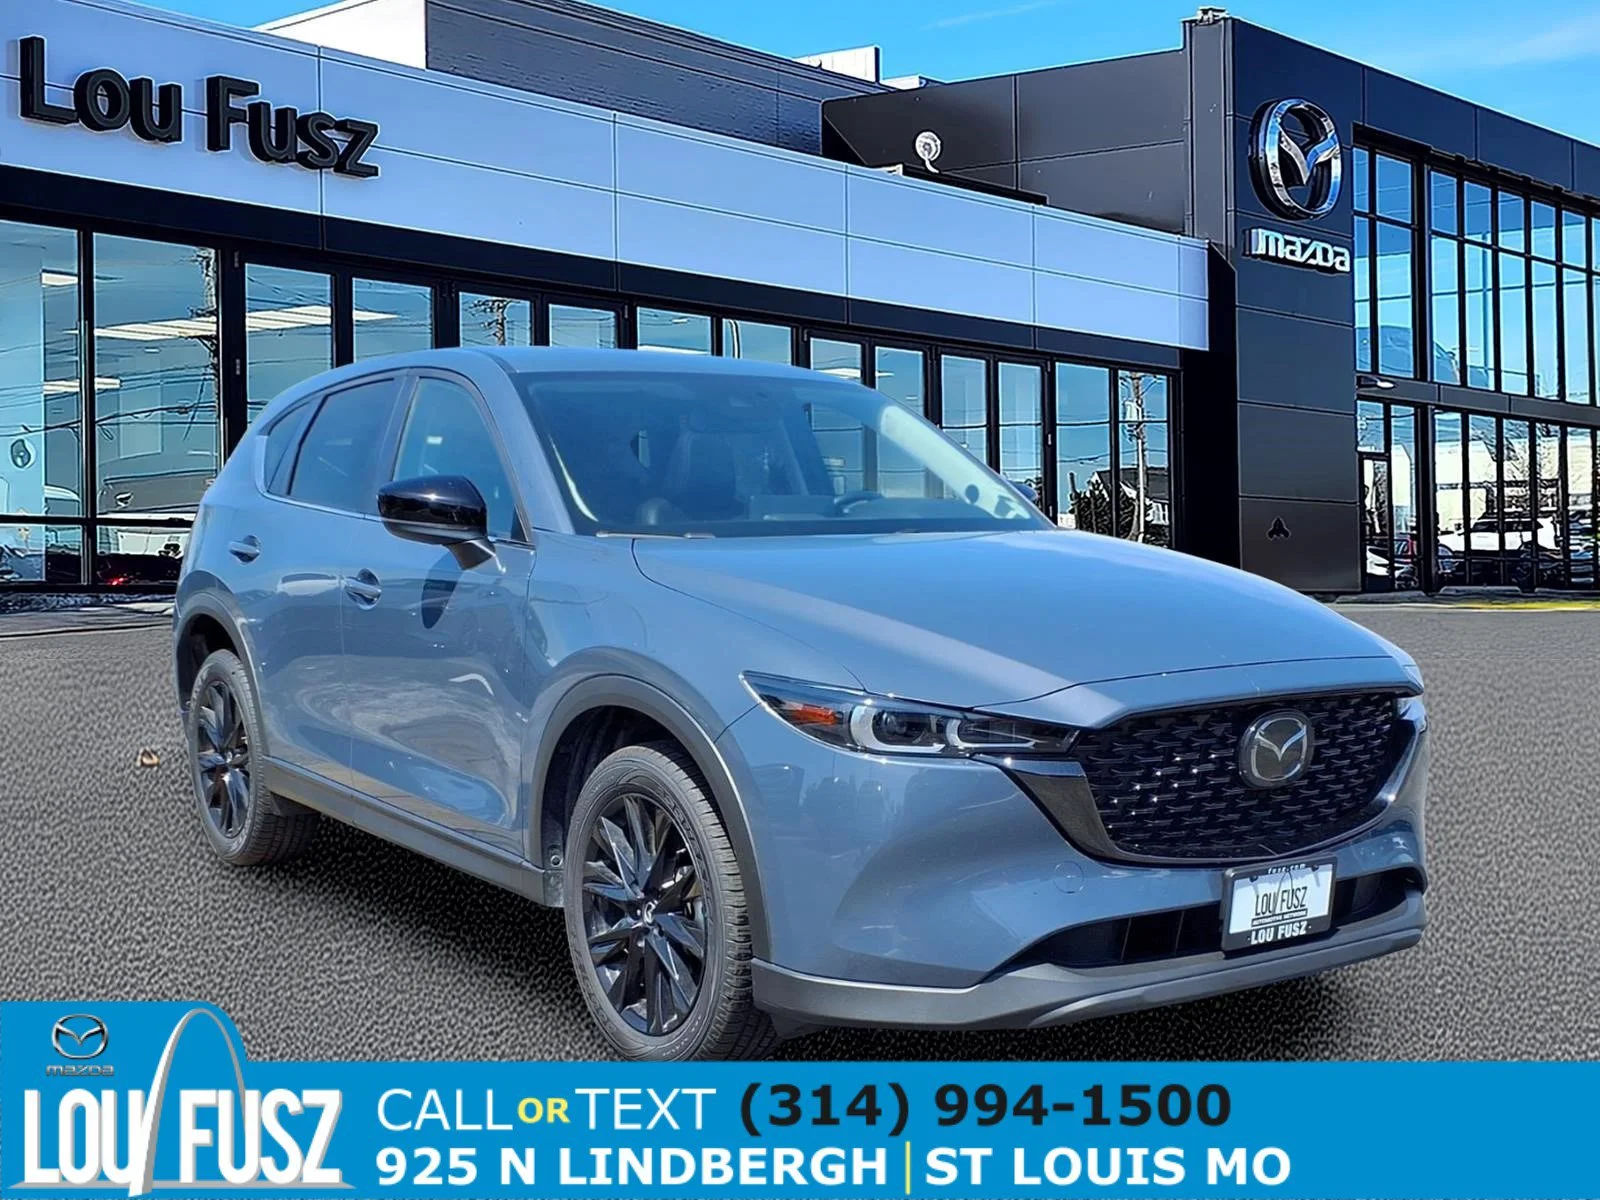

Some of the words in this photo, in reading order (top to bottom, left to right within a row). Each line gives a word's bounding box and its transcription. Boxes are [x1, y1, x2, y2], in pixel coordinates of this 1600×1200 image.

[20, 36, 182, 142] Lou
[206, 76, 379, 177] Fusz
[1255, 892, 1277, 916] LOU
[1280, 886, 1308, 910] FUSZ
[1251, 928, 1274, 945] LOU
[1277, 921, 1308, 939] FUSZ
